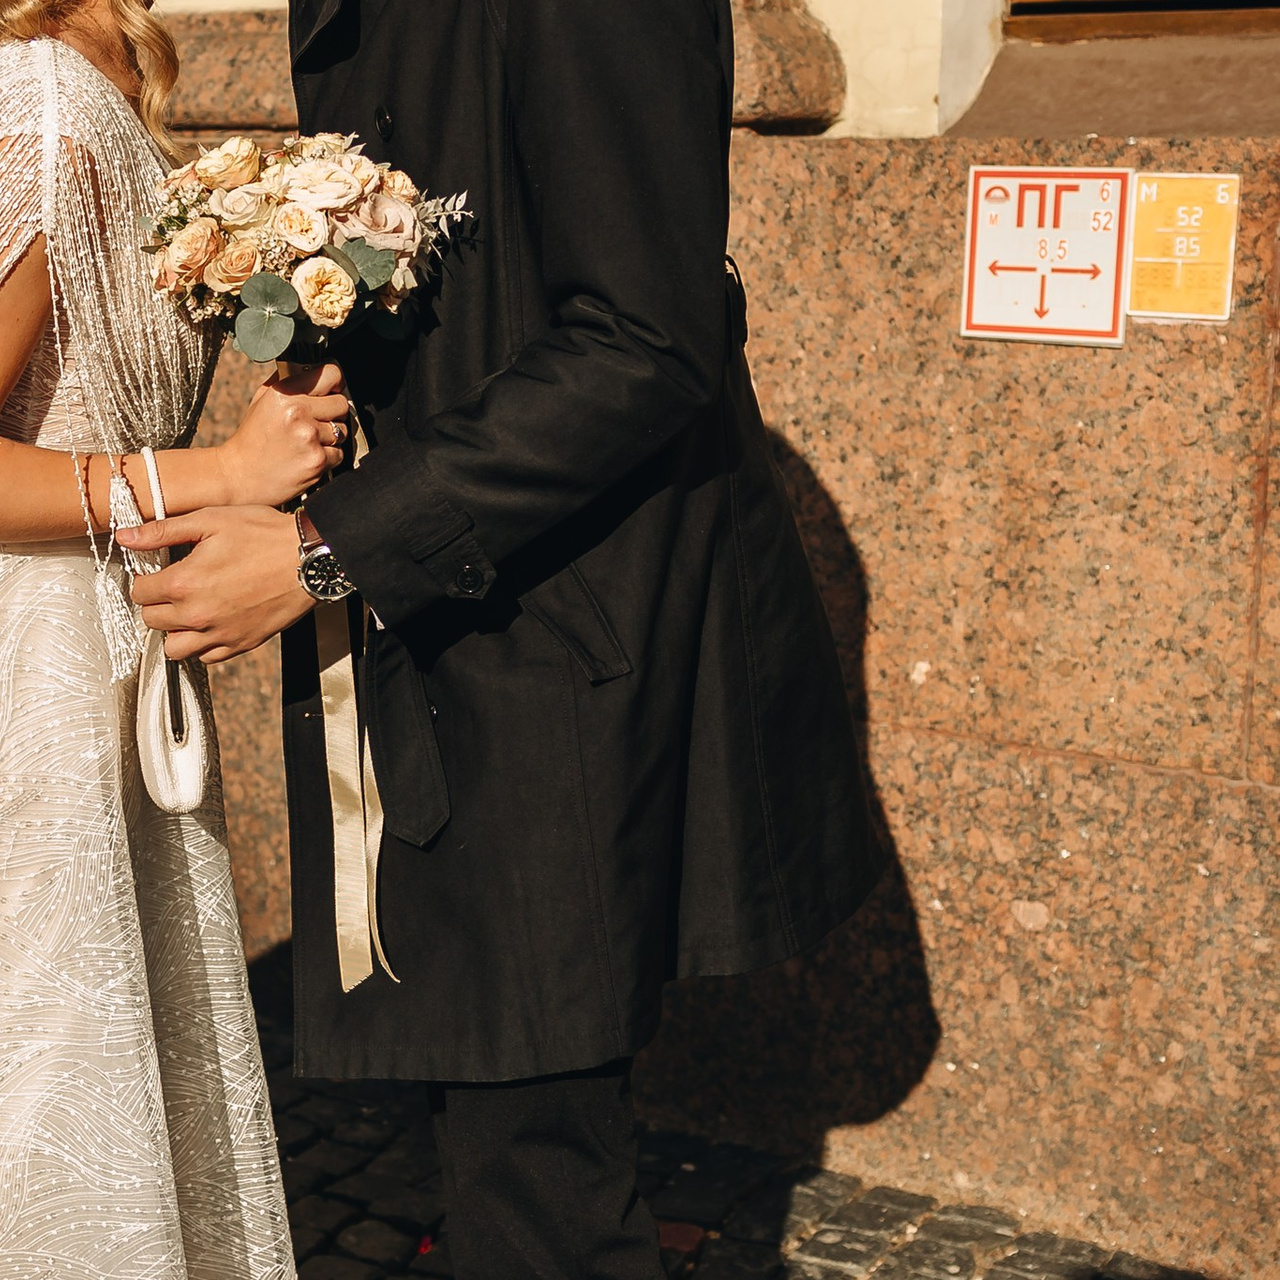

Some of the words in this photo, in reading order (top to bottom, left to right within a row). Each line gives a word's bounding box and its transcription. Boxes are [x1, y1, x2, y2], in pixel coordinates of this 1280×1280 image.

[1100, 181, 1111, 202] 6
[1216, 183, 1230, 205] 6
[1016, 184, 1080, 228] ПГ
[1177, 206, 1204, 227] 52
[1091, 211, 1113, 232] 52
